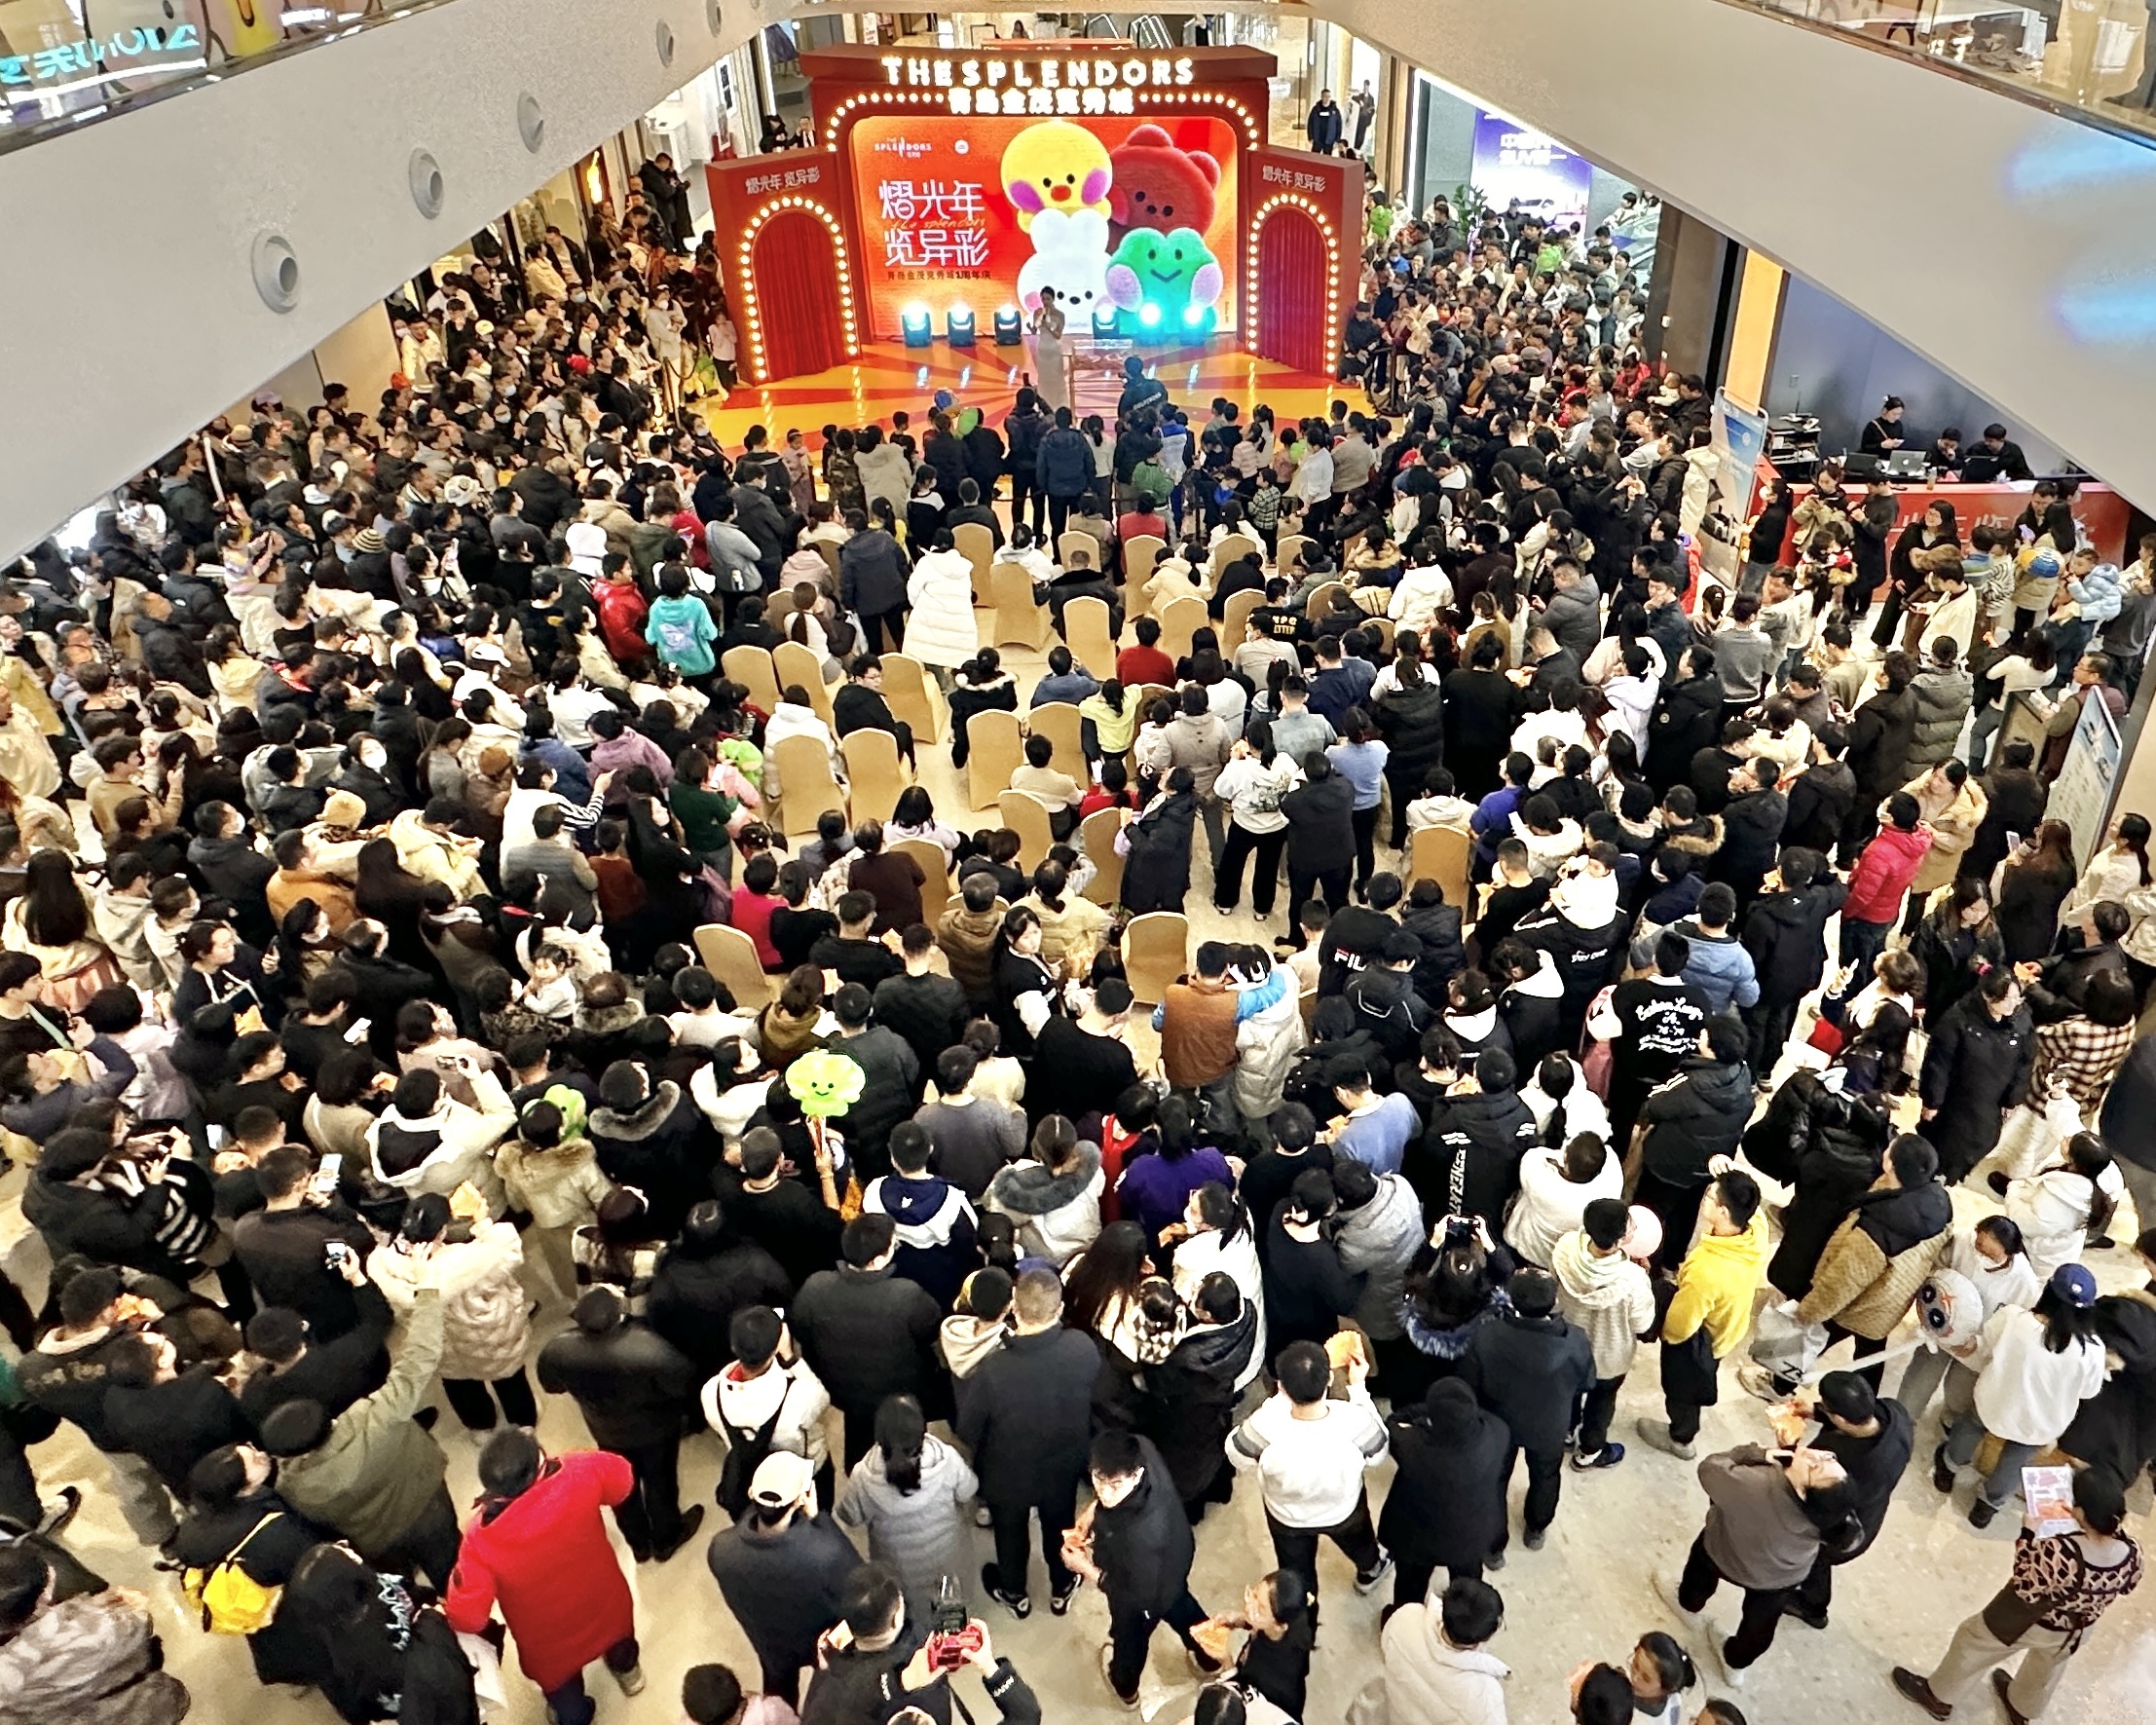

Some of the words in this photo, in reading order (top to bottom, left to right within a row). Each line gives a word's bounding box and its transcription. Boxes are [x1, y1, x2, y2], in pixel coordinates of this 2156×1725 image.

[882, 56, 952, 87] THE
[961, 56, 1194, 88] SPLENDORS
[878, 179, 985, 221] 熠光年
[884, 227, 989, 267] 览异彩
[1334, 948, 1367, 972] FIL
